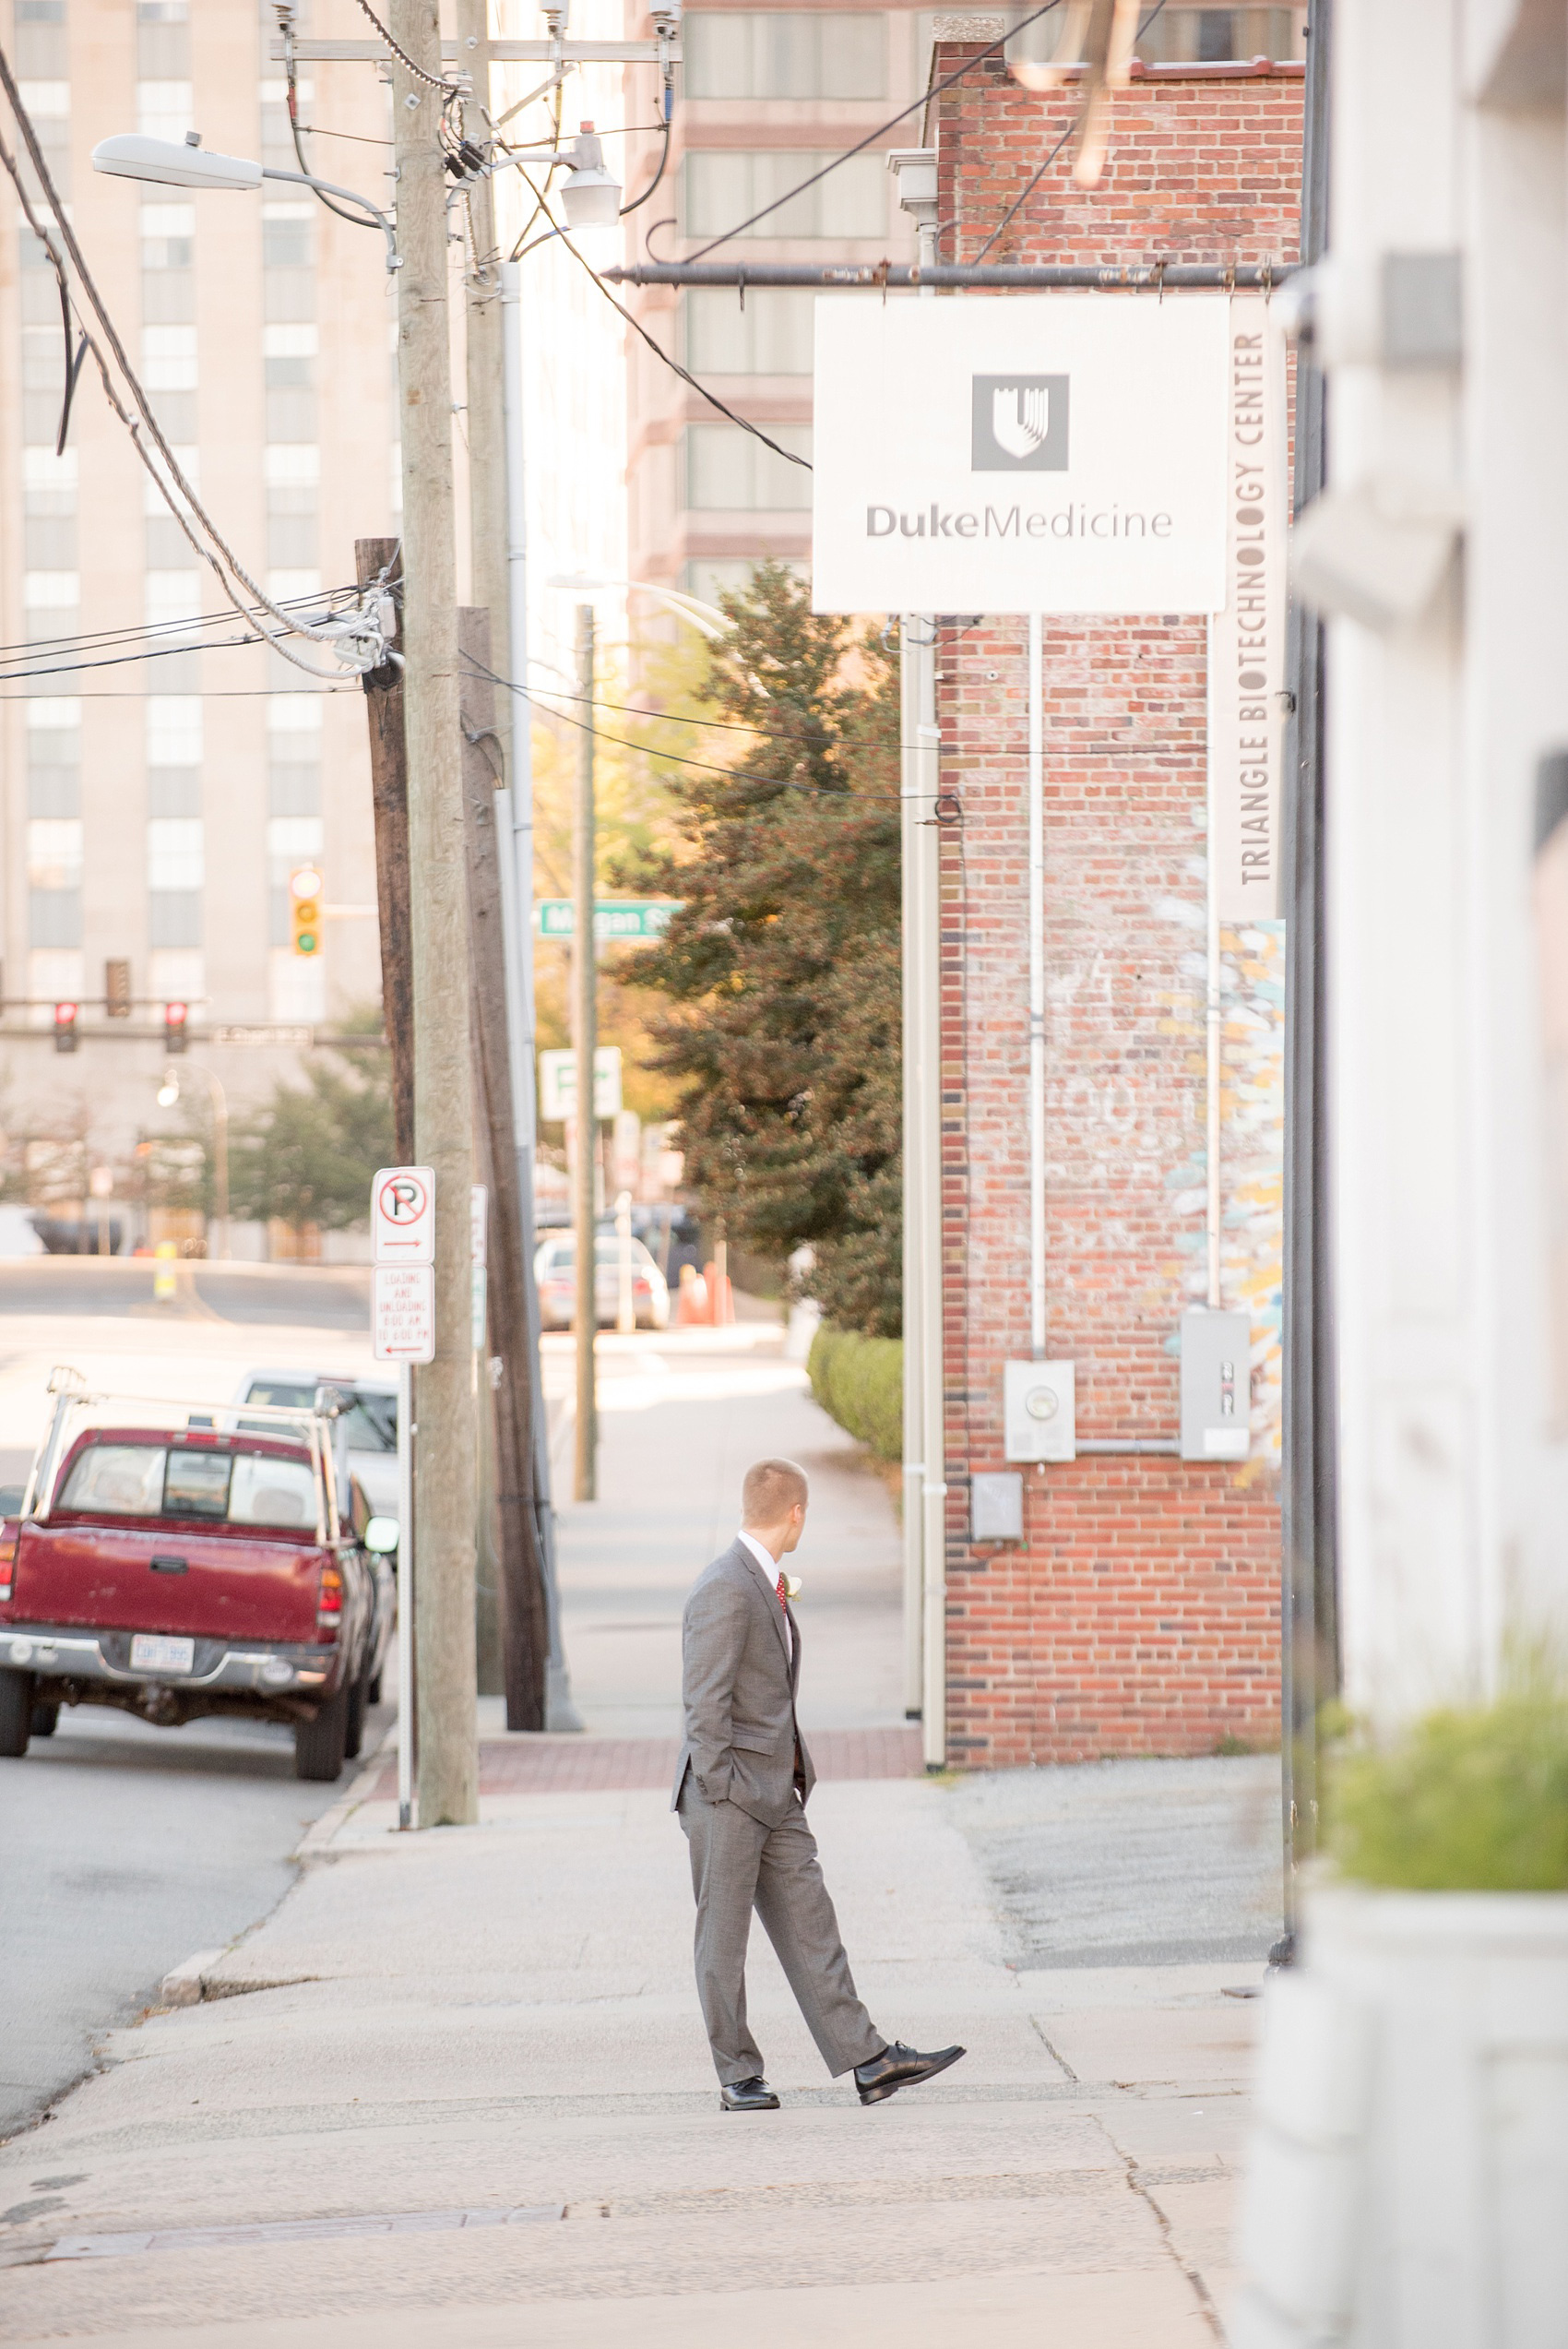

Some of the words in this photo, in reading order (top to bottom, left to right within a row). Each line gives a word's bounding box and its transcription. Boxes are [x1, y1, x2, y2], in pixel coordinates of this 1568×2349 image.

[1234, 333, 1265, 446] CENTER
[1235, 461, 1268, 721] BIOTECHNOLOGY
[1241, 736, 1271, 886] TRIANGLE
[547, 905, 641, 937] Mgan
[385, 1272, 421, 1285] LOADING
[394, 1287, 412, 1298] AND
[380, 1300, 426, 1313] UNLOADING
[409, 1314, 422, 1326] AM
[417, 1328, 430, 1340] PM
